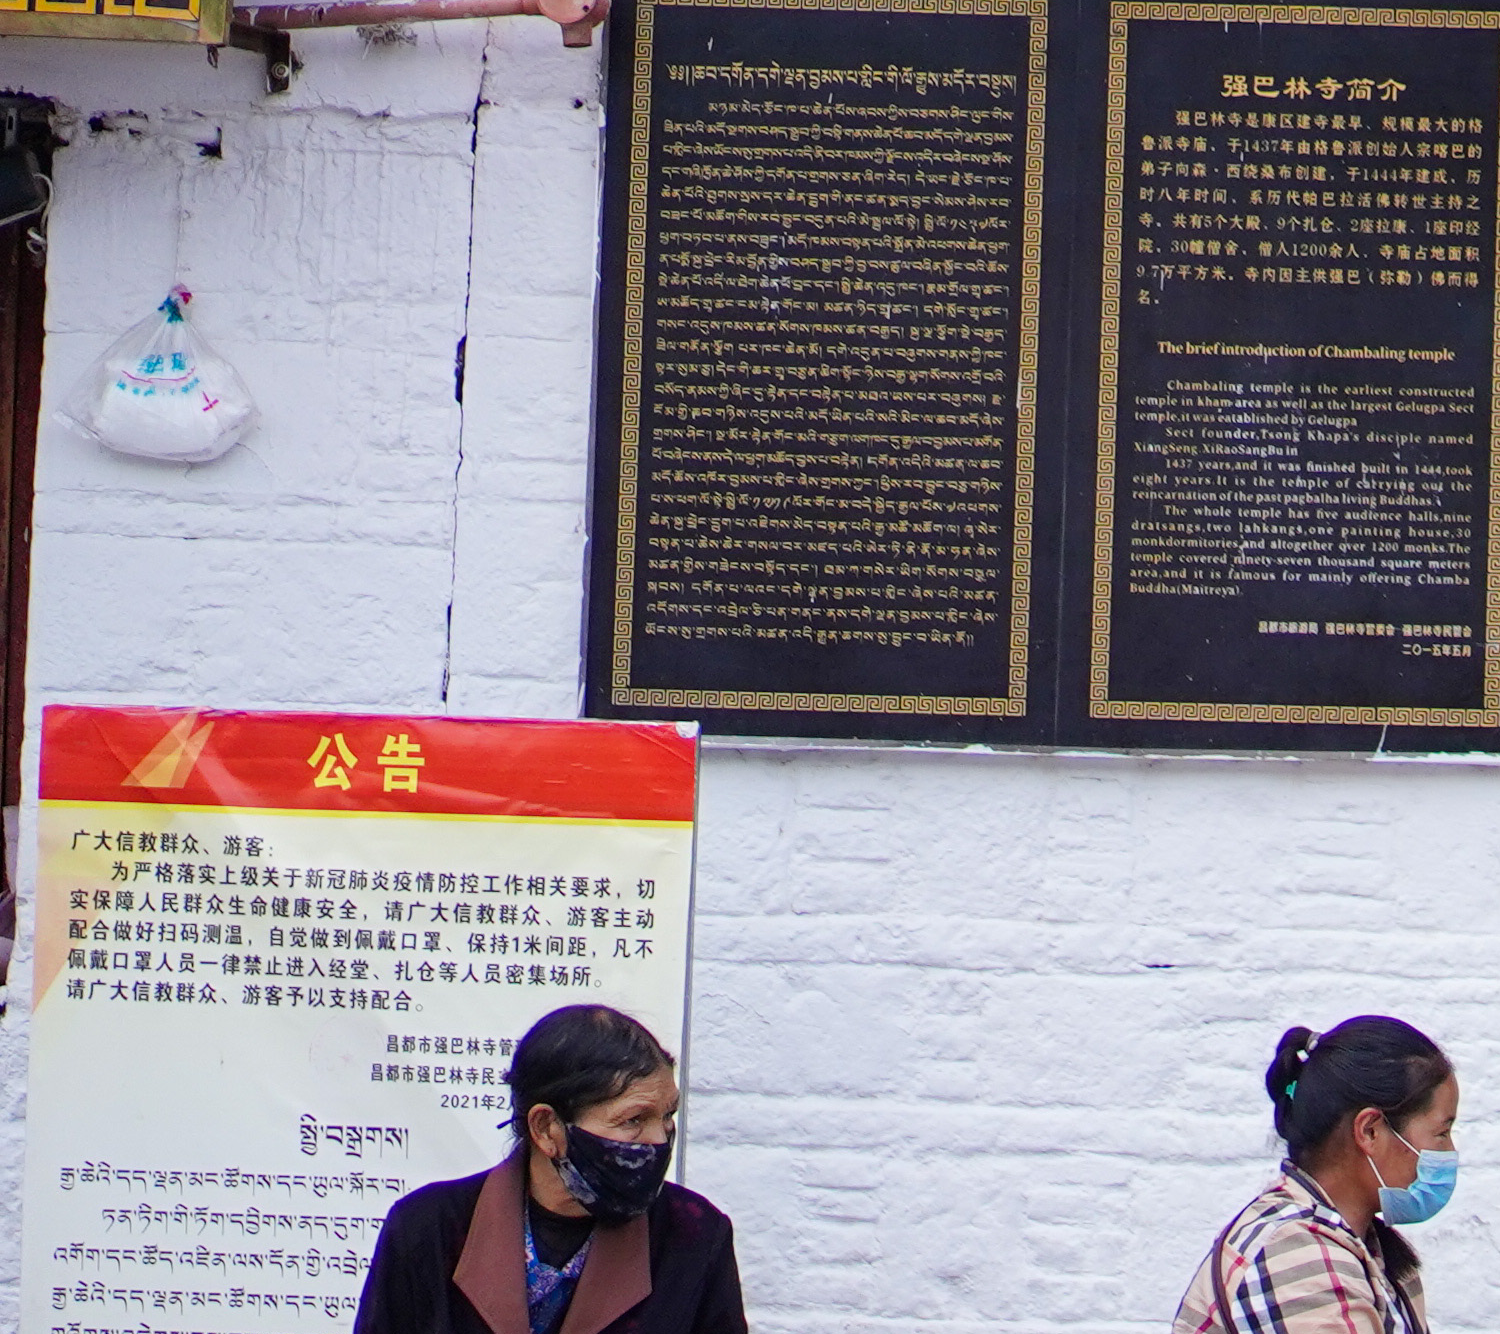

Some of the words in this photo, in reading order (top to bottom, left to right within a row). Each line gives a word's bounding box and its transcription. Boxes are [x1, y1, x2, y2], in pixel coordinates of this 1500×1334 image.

[1221, 75, 1407, 102] 强巴林寺简介
[1158, 341, 1183, 354] The
[1186, 342, 1221, 355] brief
[1221, 343, 1306, 357] introduction
[1308, 345, 1323, 357] of
[1324, 345, 1406, 362] Chambaling
[1408, 347, 1455, 363] temple
[1167, 379, 1243, 396] Chambaling
[1250, 381, 1293, 397] temple
[1300, 383, 1311, 394] is
[1318, 383, 1338, 394] the
[1345, 384, 1392, 396] earliest
[1399, 385, 1474, 398] constructed
[1135, 394, 1177, 410] temple
[1182, 396, 1193, 406] in
[1265, 399, 1278, 408] as
[1282, 397, 1306, 409] well
[1311, 400, 1323, 409] as
[1328, 398, 1347, 410] the
[1351, 399, 1392, 415] largest
[1396, 400, 1445, 416] Gelugpa
[1449, 401, 1474, 413] Sect
[1193, 413, 1215, 422] was
[1291, 413, 1305, 429] by
[1308, 414, 1357, 430] Gelugpa
[1166, 425, 1193, 438] Sect
[1308, 429, 1359, 446] Khapa's
[1366, 430, 1421, 447] disciple
[1428, 432, 1473, 445] named
[1286, 445, 1298, 455] in
[1166, 456, 1192, 469] 1437
[1264, 460, 1272, 471] it
[1278, 461, 1301, 472] was
[1307, 460, 1355, 473] finished
[1361, 461, 1390, 474] built
[1396, 463, 1408, 474] in
[1133, 472, 1167, 488] eight
[1235, 475, 1245, 486] is
[1253, 474, 1274, 487] the
[1282, 475, 1328, 492] temple
[1336, 476, 1350, 489] of
[1451, 479, 1472, 492] the
[1133, 489, 1217, 501] reincarnation
[1219, 490, 1232, 501] of
[1234, 490, 1253, 501] the
[1256, 491, 1281, 506] past
[1342, 492, 1377, 508] living
[1164, 503, 1187, 516] The
[1193, 504, 1231, 517] whole
[1238, 505, 1281, 522] temple
[1289, 506, 1309, 519] has
[1317, 507, 1338, 519] five
[1345, 508, 1402, 521] audience
[1409, 509, 1471, 525] halls,nine
[1341, 525, 1401, 541] painting
[1409, 526, 1471, 541] house,30
[1270, 538, 1333, 554] altogether
[1373, 540, 1399, 552] 1200
[1131, 550, 1173, 566] temple
[1179, 552, 1227, 564] covered
[1318, 555, 1374, 567] thousand
[1381, 558, 1422, 572] square
[1428, 559, 1470, 569] meters
[1194, 568, 1203, 578] it
[1211, 568, 1221, 579] is
[1228, 568, 1275, 580] famous
[1283, 569, 1301, 581] for
[1309, 570, 1353, 586] mainly
[1360, 571, 1411, 587] offering
[1418, 572, 1469, 584] Chamba
[307, 733, 425, 794] 公告
[111, 861, 656, 900] 为严格落实上级关于新冠肺炎疫情防控工作相关要求，切
[69, 889, 655, 929] 实保障人民群众生命健康安全，请广大信教群众、游客主动
[68, 919, 654, 959] 配合做好扫码测温，自觉做到佩戴口罩、保持1米间距，凡不
[68, 948, 602, 988] 佩戴口罩人员一律禁止进入经堂、扎仓等人员密集场所。
[67, 978, 424, 1012] 请广大信教群众、游客予以支持配合。
[440, 1094, 512, 1111] 2021年2
